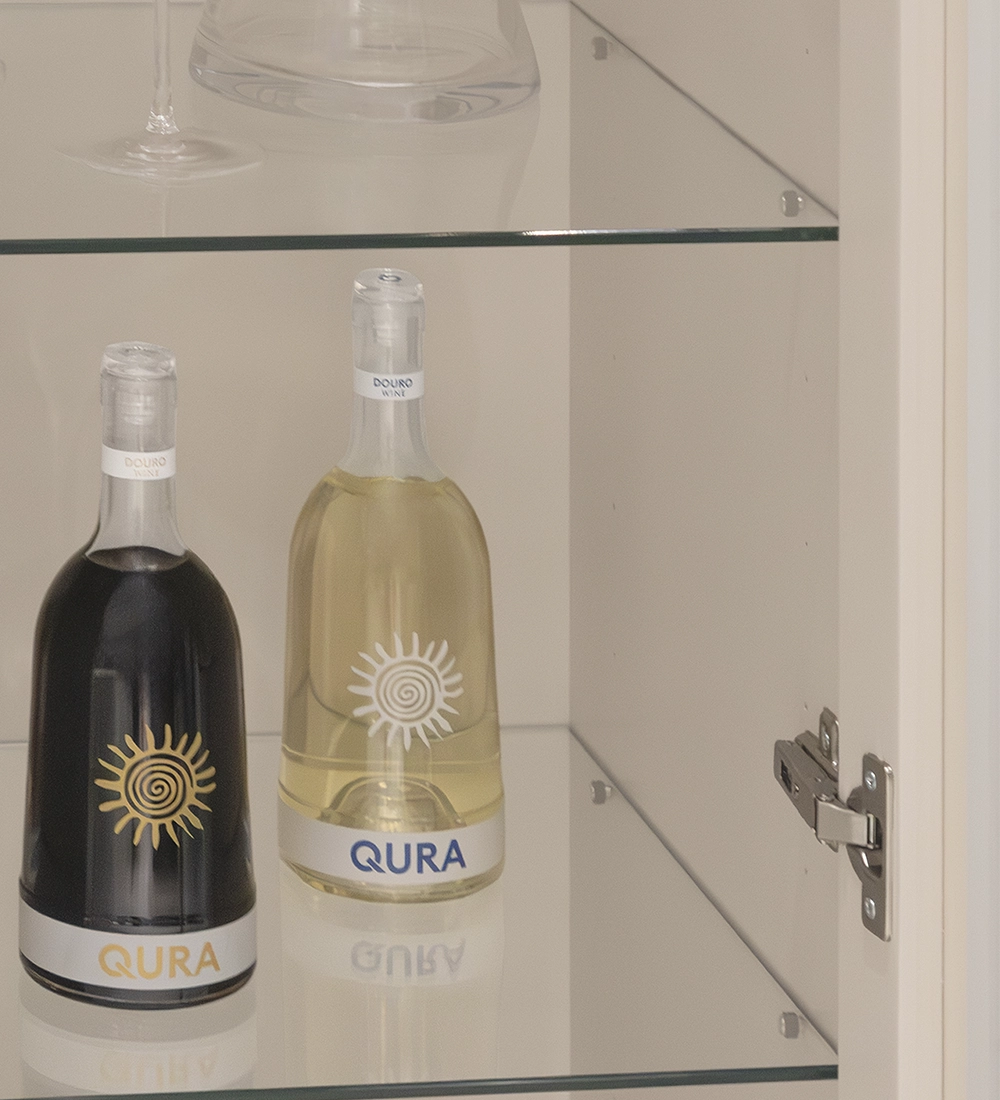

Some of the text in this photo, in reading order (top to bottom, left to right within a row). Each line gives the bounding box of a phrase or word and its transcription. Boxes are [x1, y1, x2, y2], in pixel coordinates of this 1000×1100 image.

[373, 377, 413, 388] DOURO
[381, 389, 406, 397] WINE
[124, 456, 167, 468] DOURO
[350, 839, 467, 874] QURA
[98, 942, 221, 979] QURA
